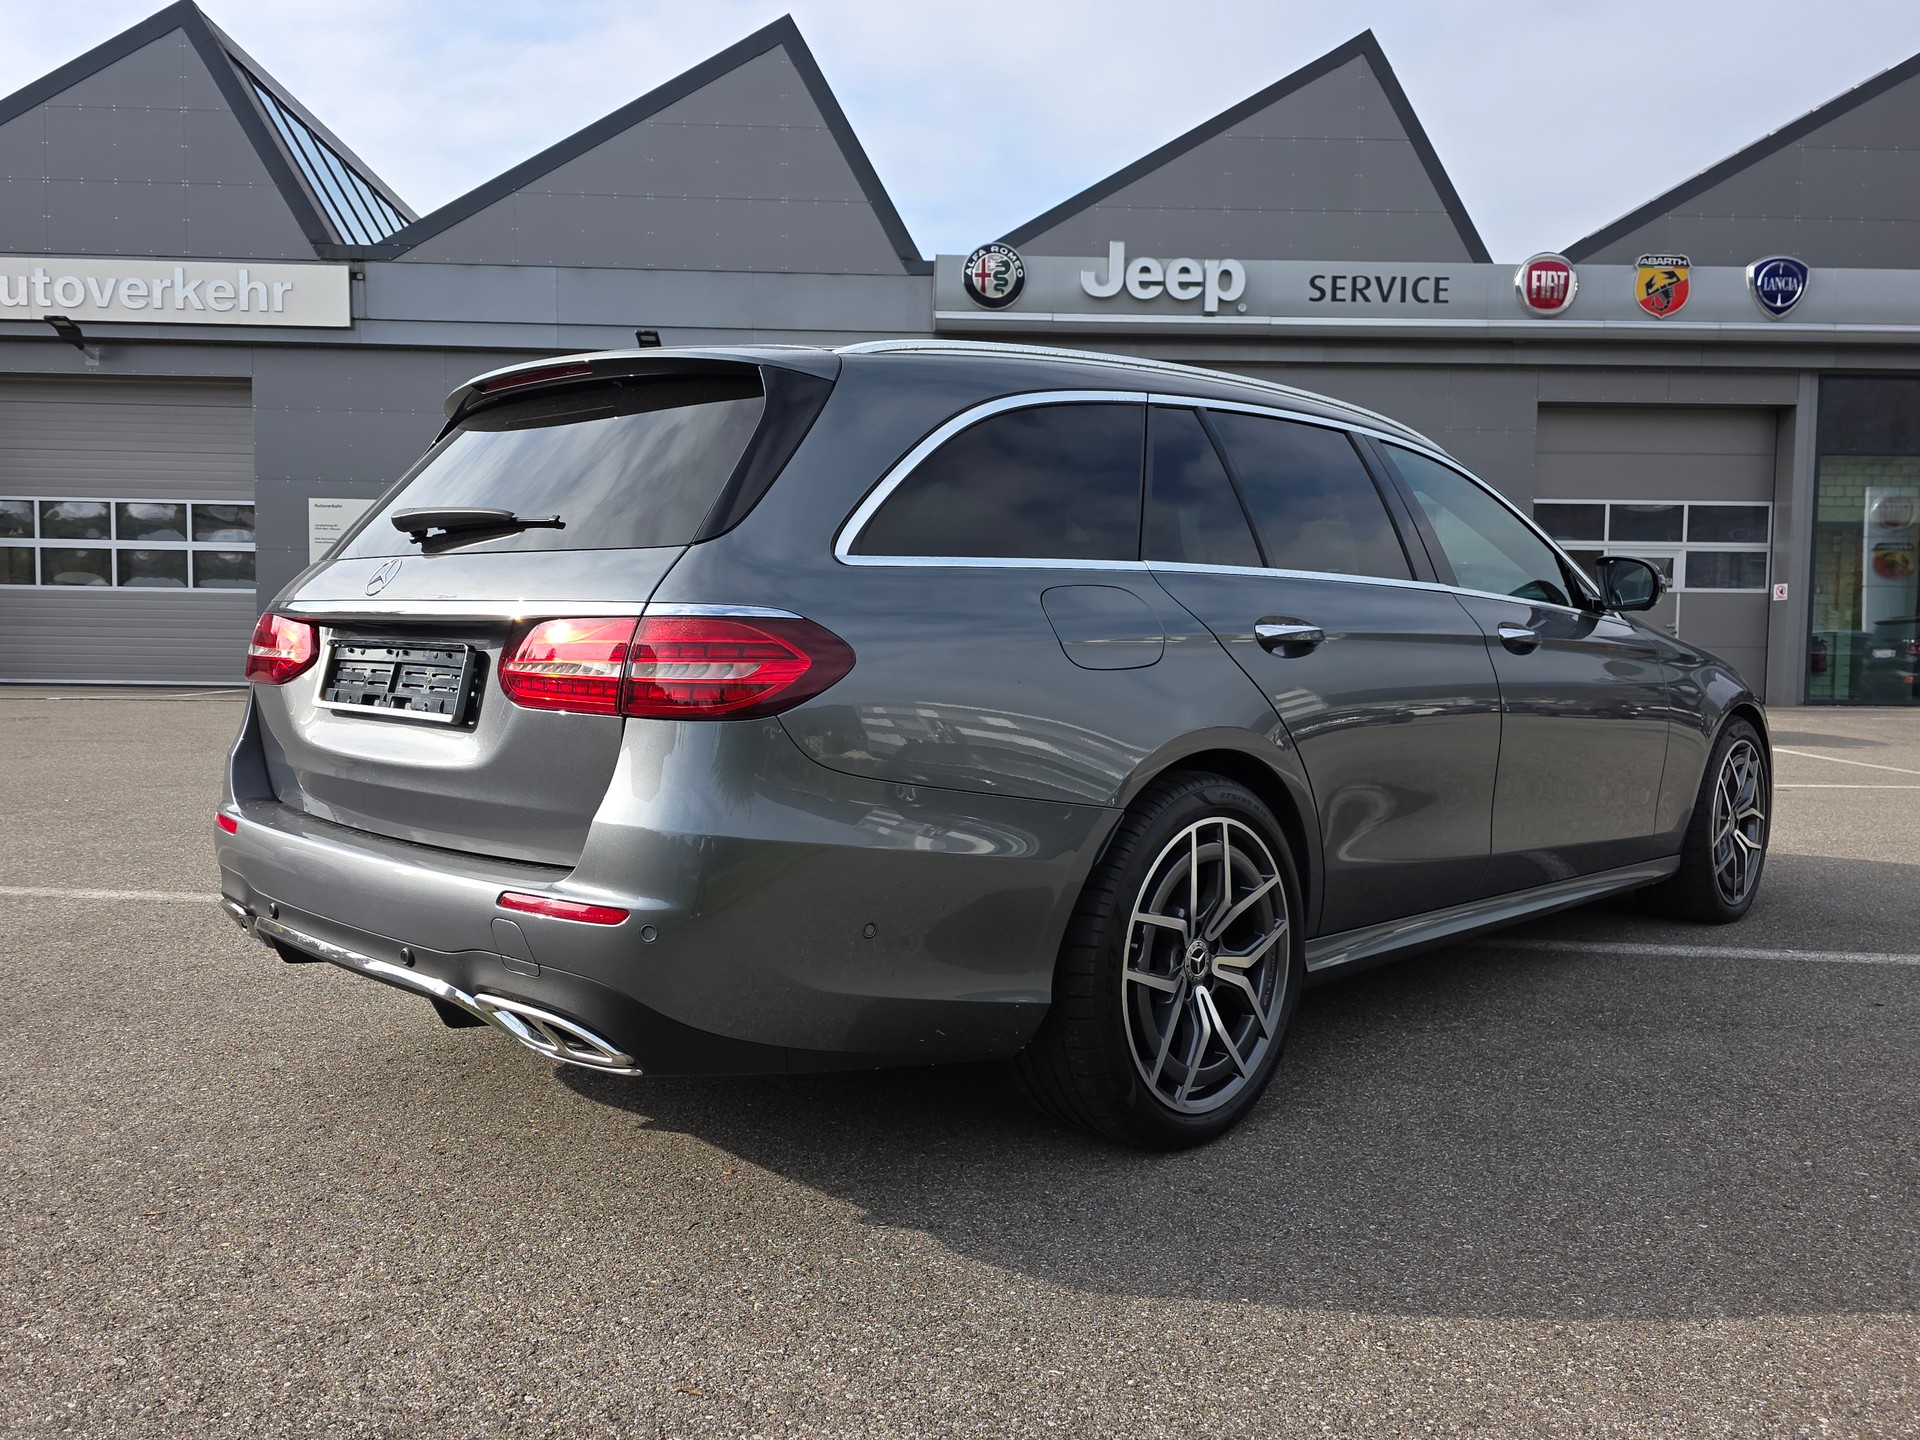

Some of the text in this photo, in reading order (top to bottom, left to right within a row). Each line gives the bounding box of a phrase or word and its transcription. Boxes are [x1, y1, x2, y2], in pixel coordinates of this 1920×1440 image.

[965, 245, 1024, 278] ALFA ROMEO
[1640, 256, 1687, 266] ABARTH
[0, 267, 293, 312] utoverkehr
[1081, 240, 1246, 313] Jeep
[1308, 274, 1450, 304] SERVICE
[1531, 269, 1568, 299] FIAT
[1763, 276, 1798, 292] LANCIA
